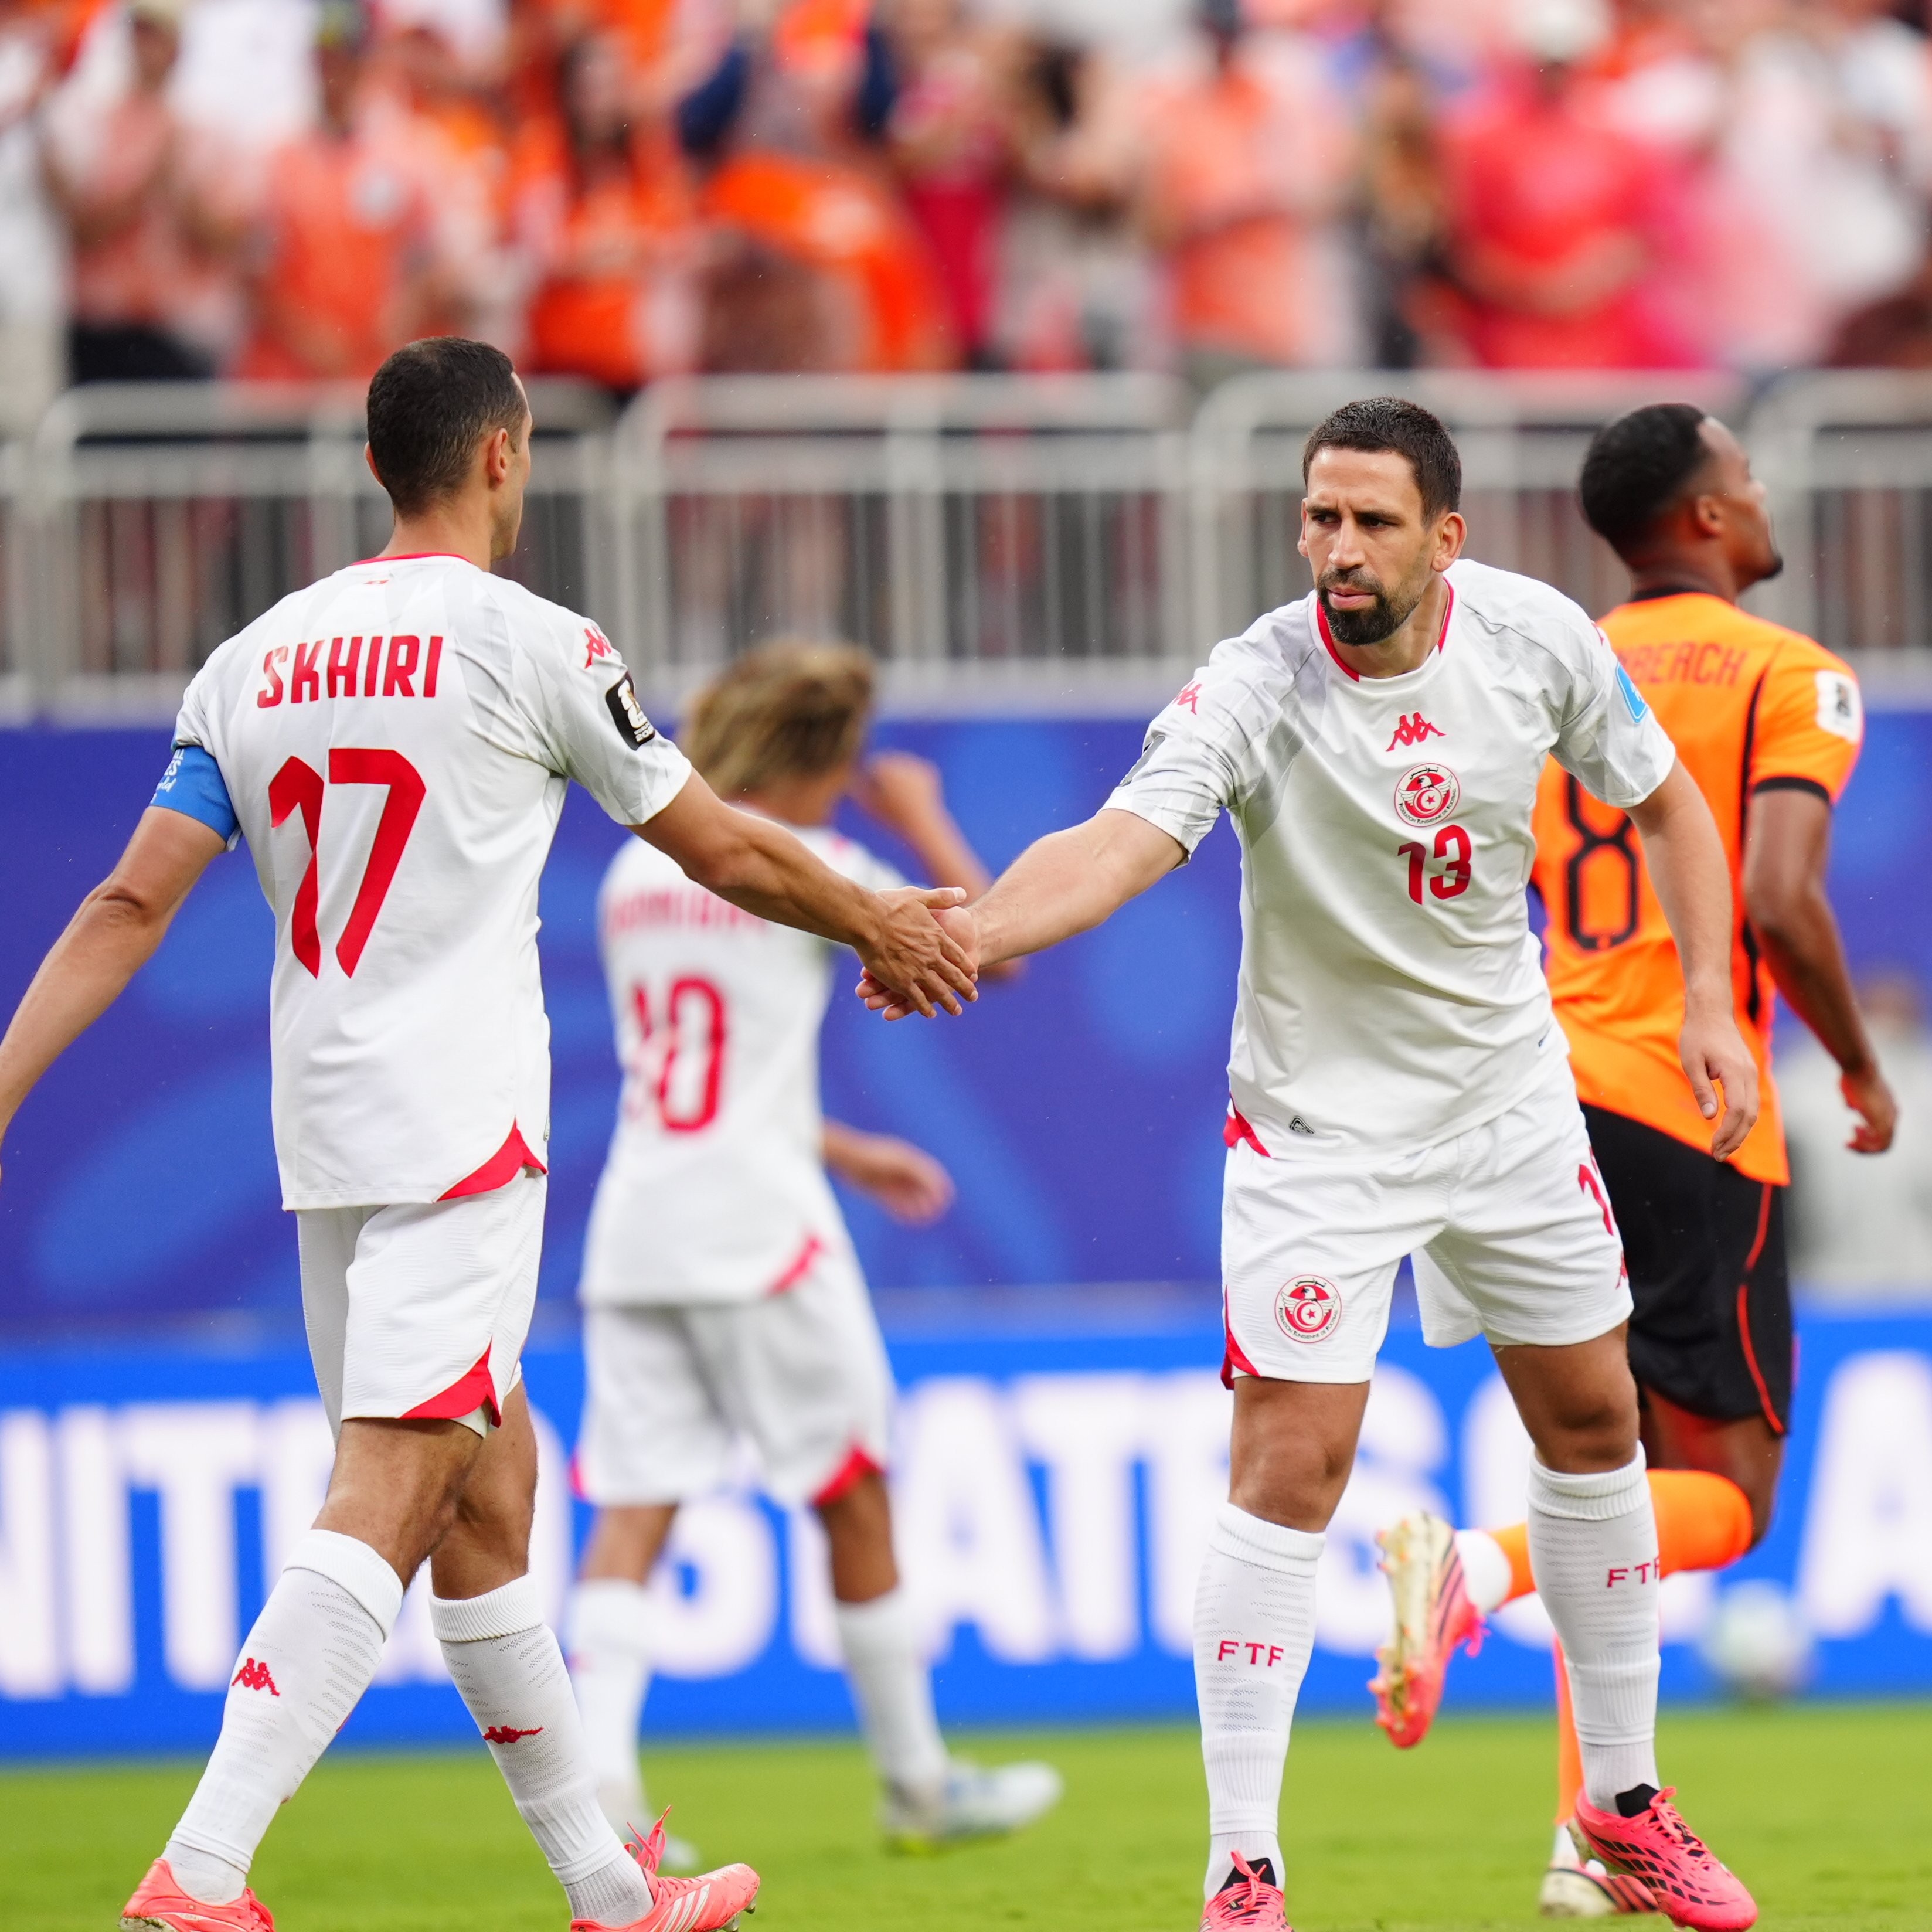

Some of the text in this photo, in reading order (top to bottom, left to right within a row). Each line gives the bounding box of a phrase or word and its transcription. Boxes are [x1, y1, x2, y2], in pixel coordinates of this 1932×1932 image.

[258, 635, 444, 708] SKHIRI
[268, 747, 427, 979] 17
[1398, 825, 1473, 904] 13
[1218, 1640, 1284, 1667] FTF
